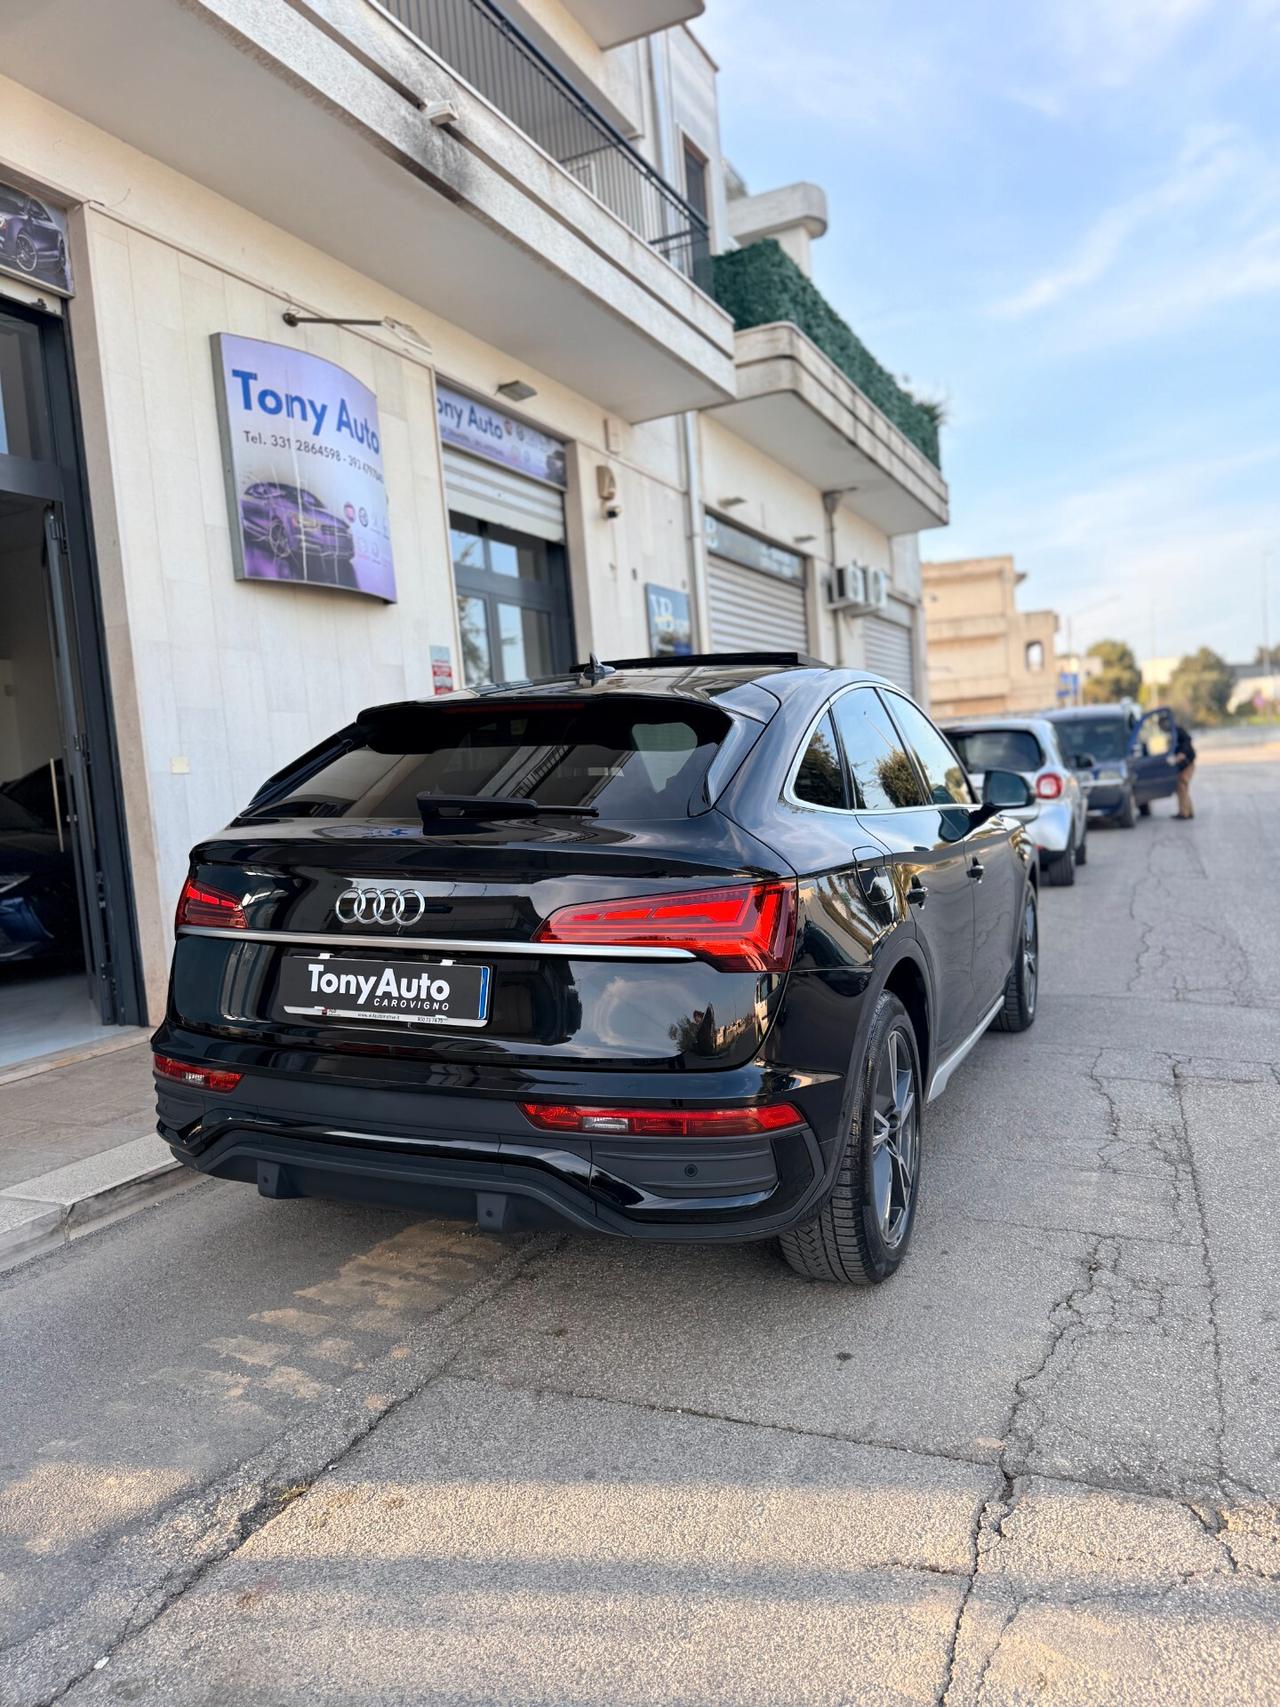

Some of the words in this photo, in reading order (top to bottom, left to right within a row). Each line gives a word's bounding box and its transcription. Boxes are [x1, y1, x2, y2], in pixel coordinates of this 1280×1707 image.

[232, 369, 328, 437] Tony
[336, 397, 380, 455] Auto
[437, 397, 463, 429] ony
[468, 404, 503, 440] Auto
[243, 430, 267, 446] Tel.
[271, 434, 292, 450] 331
[295, 439, 342, 462] 2864598
[308, 964, 450, 1004] TonyAuto
[373, 997, 449, 1011] CAROVIGNO
